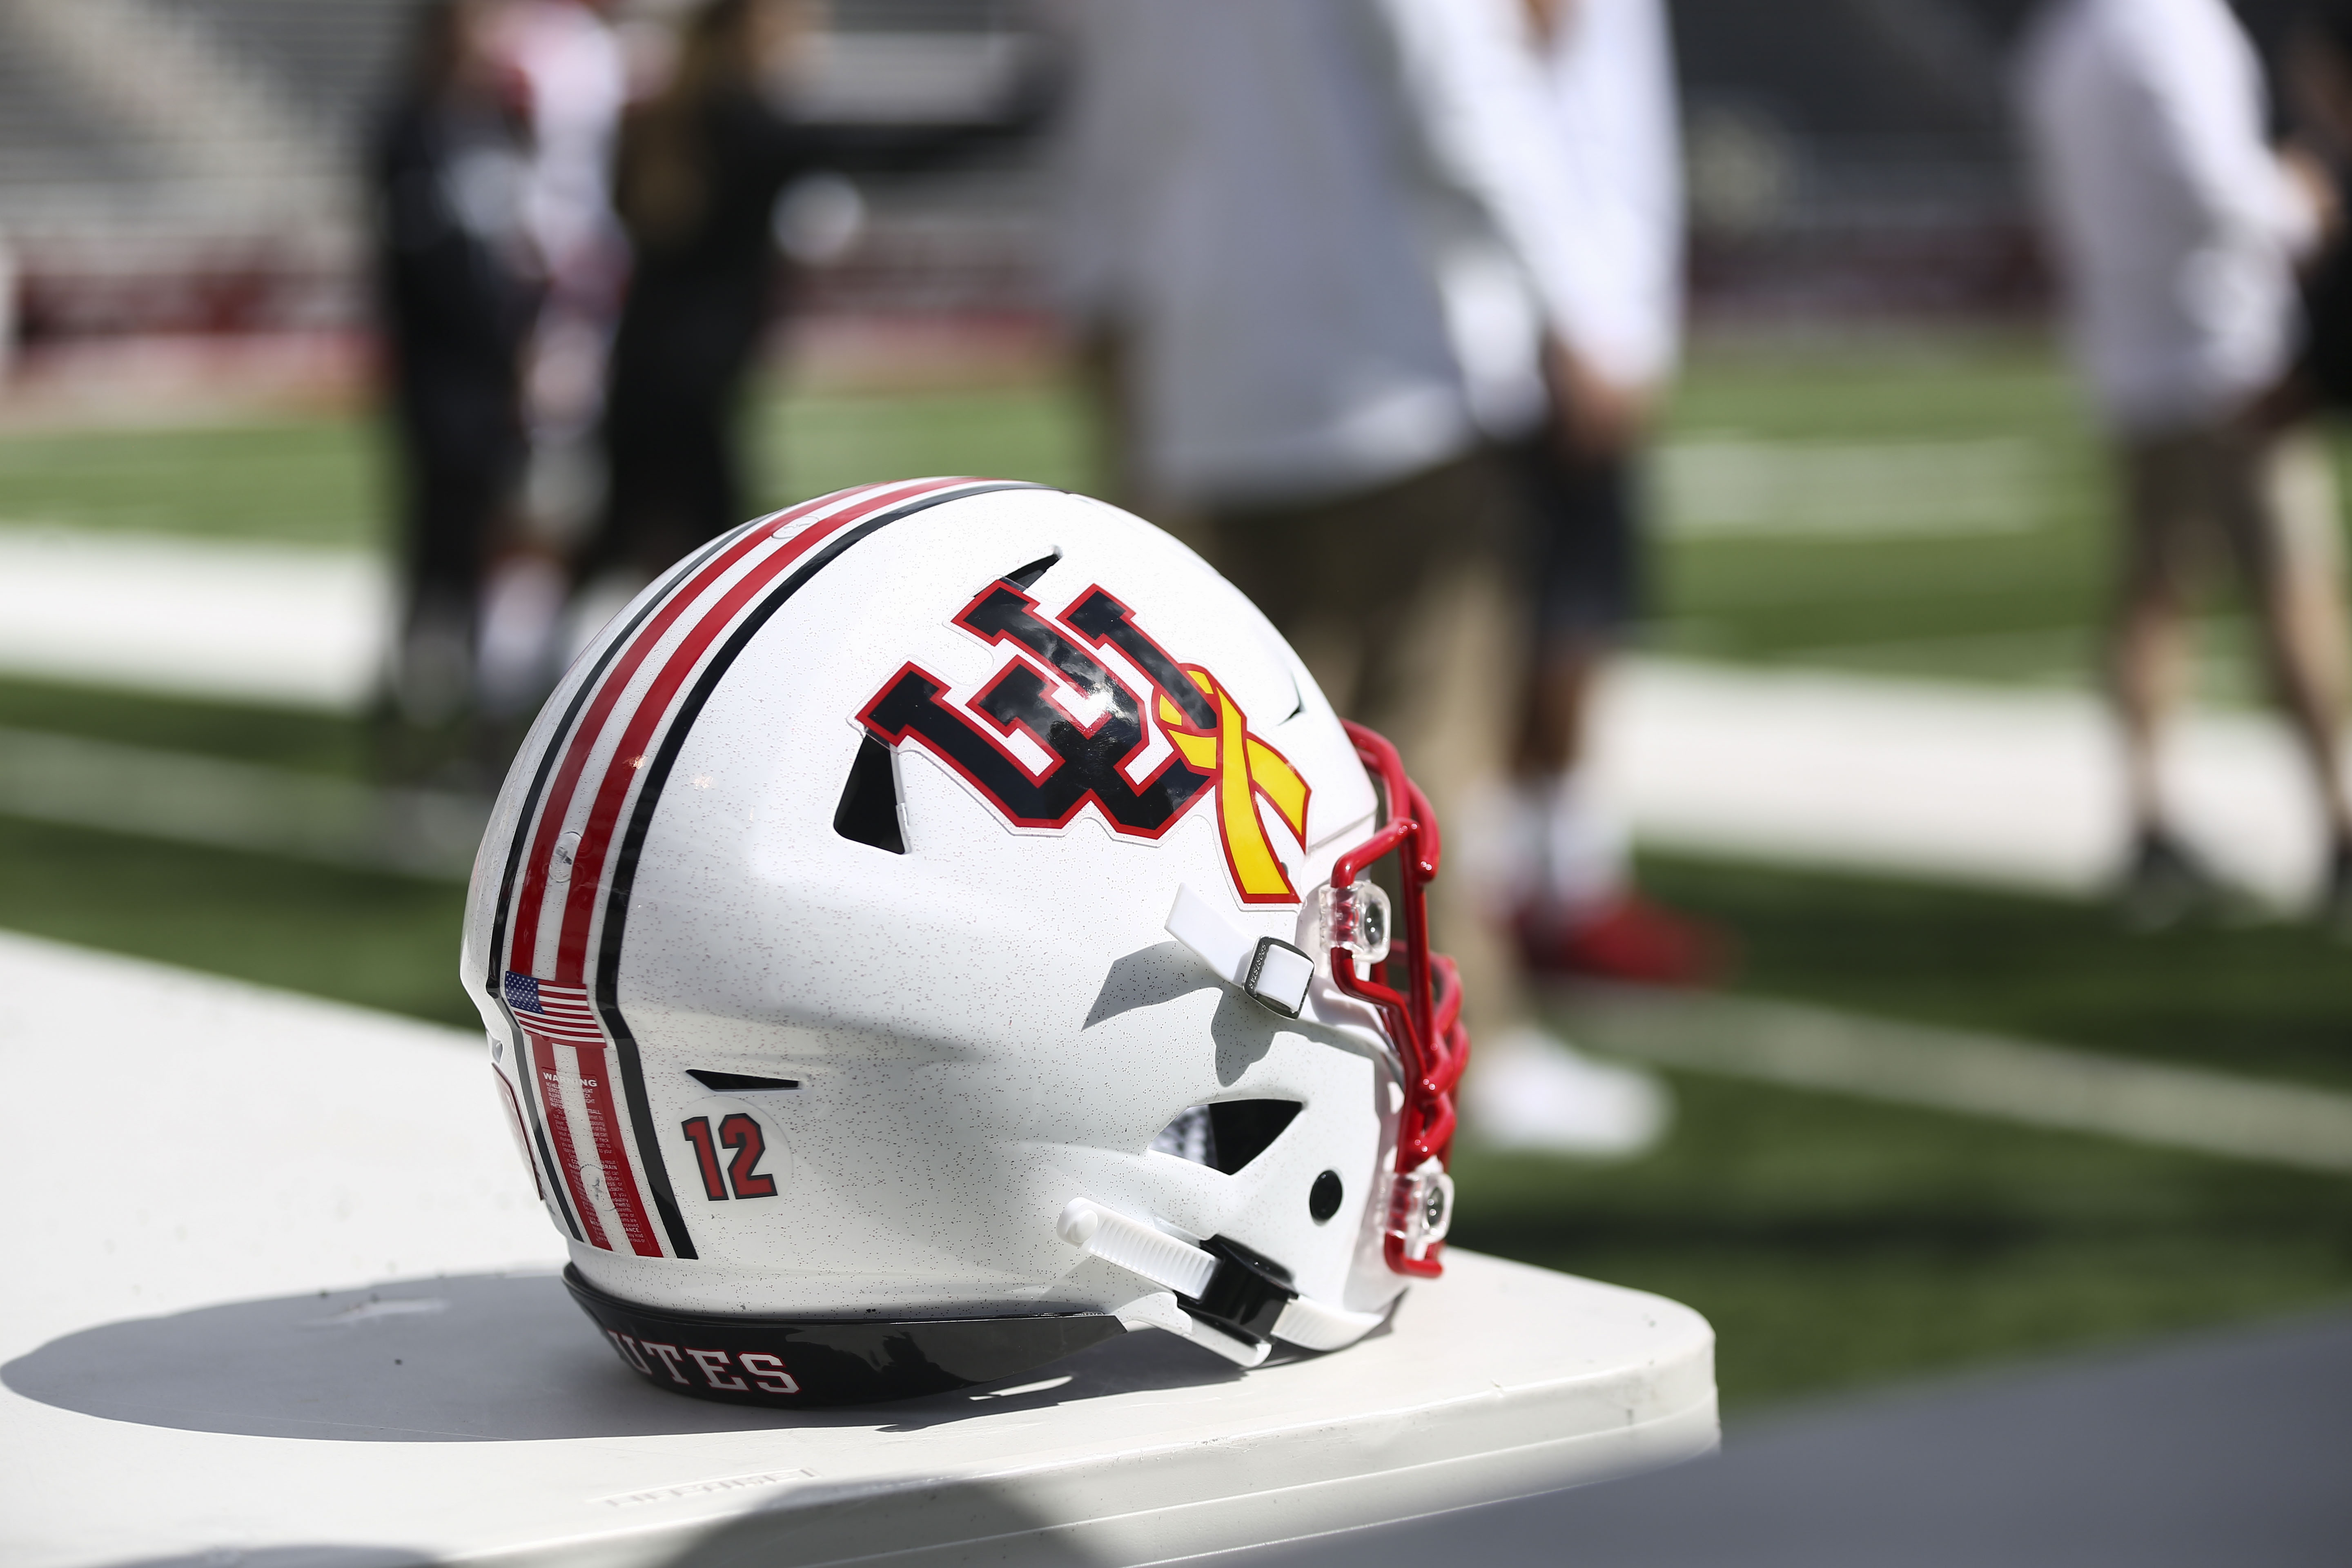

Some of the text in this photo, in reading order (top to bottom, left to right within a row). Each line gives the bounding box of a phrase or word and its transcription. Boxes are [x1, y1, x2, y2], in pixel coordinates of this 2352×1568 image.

[1249, 942, 1266, 989] SPORTSTAR
[543, 1071, 597, 1087] WARNING
[681, 1112, 778, 1201] 12
[607, 1329, 802, 1394] UTES
